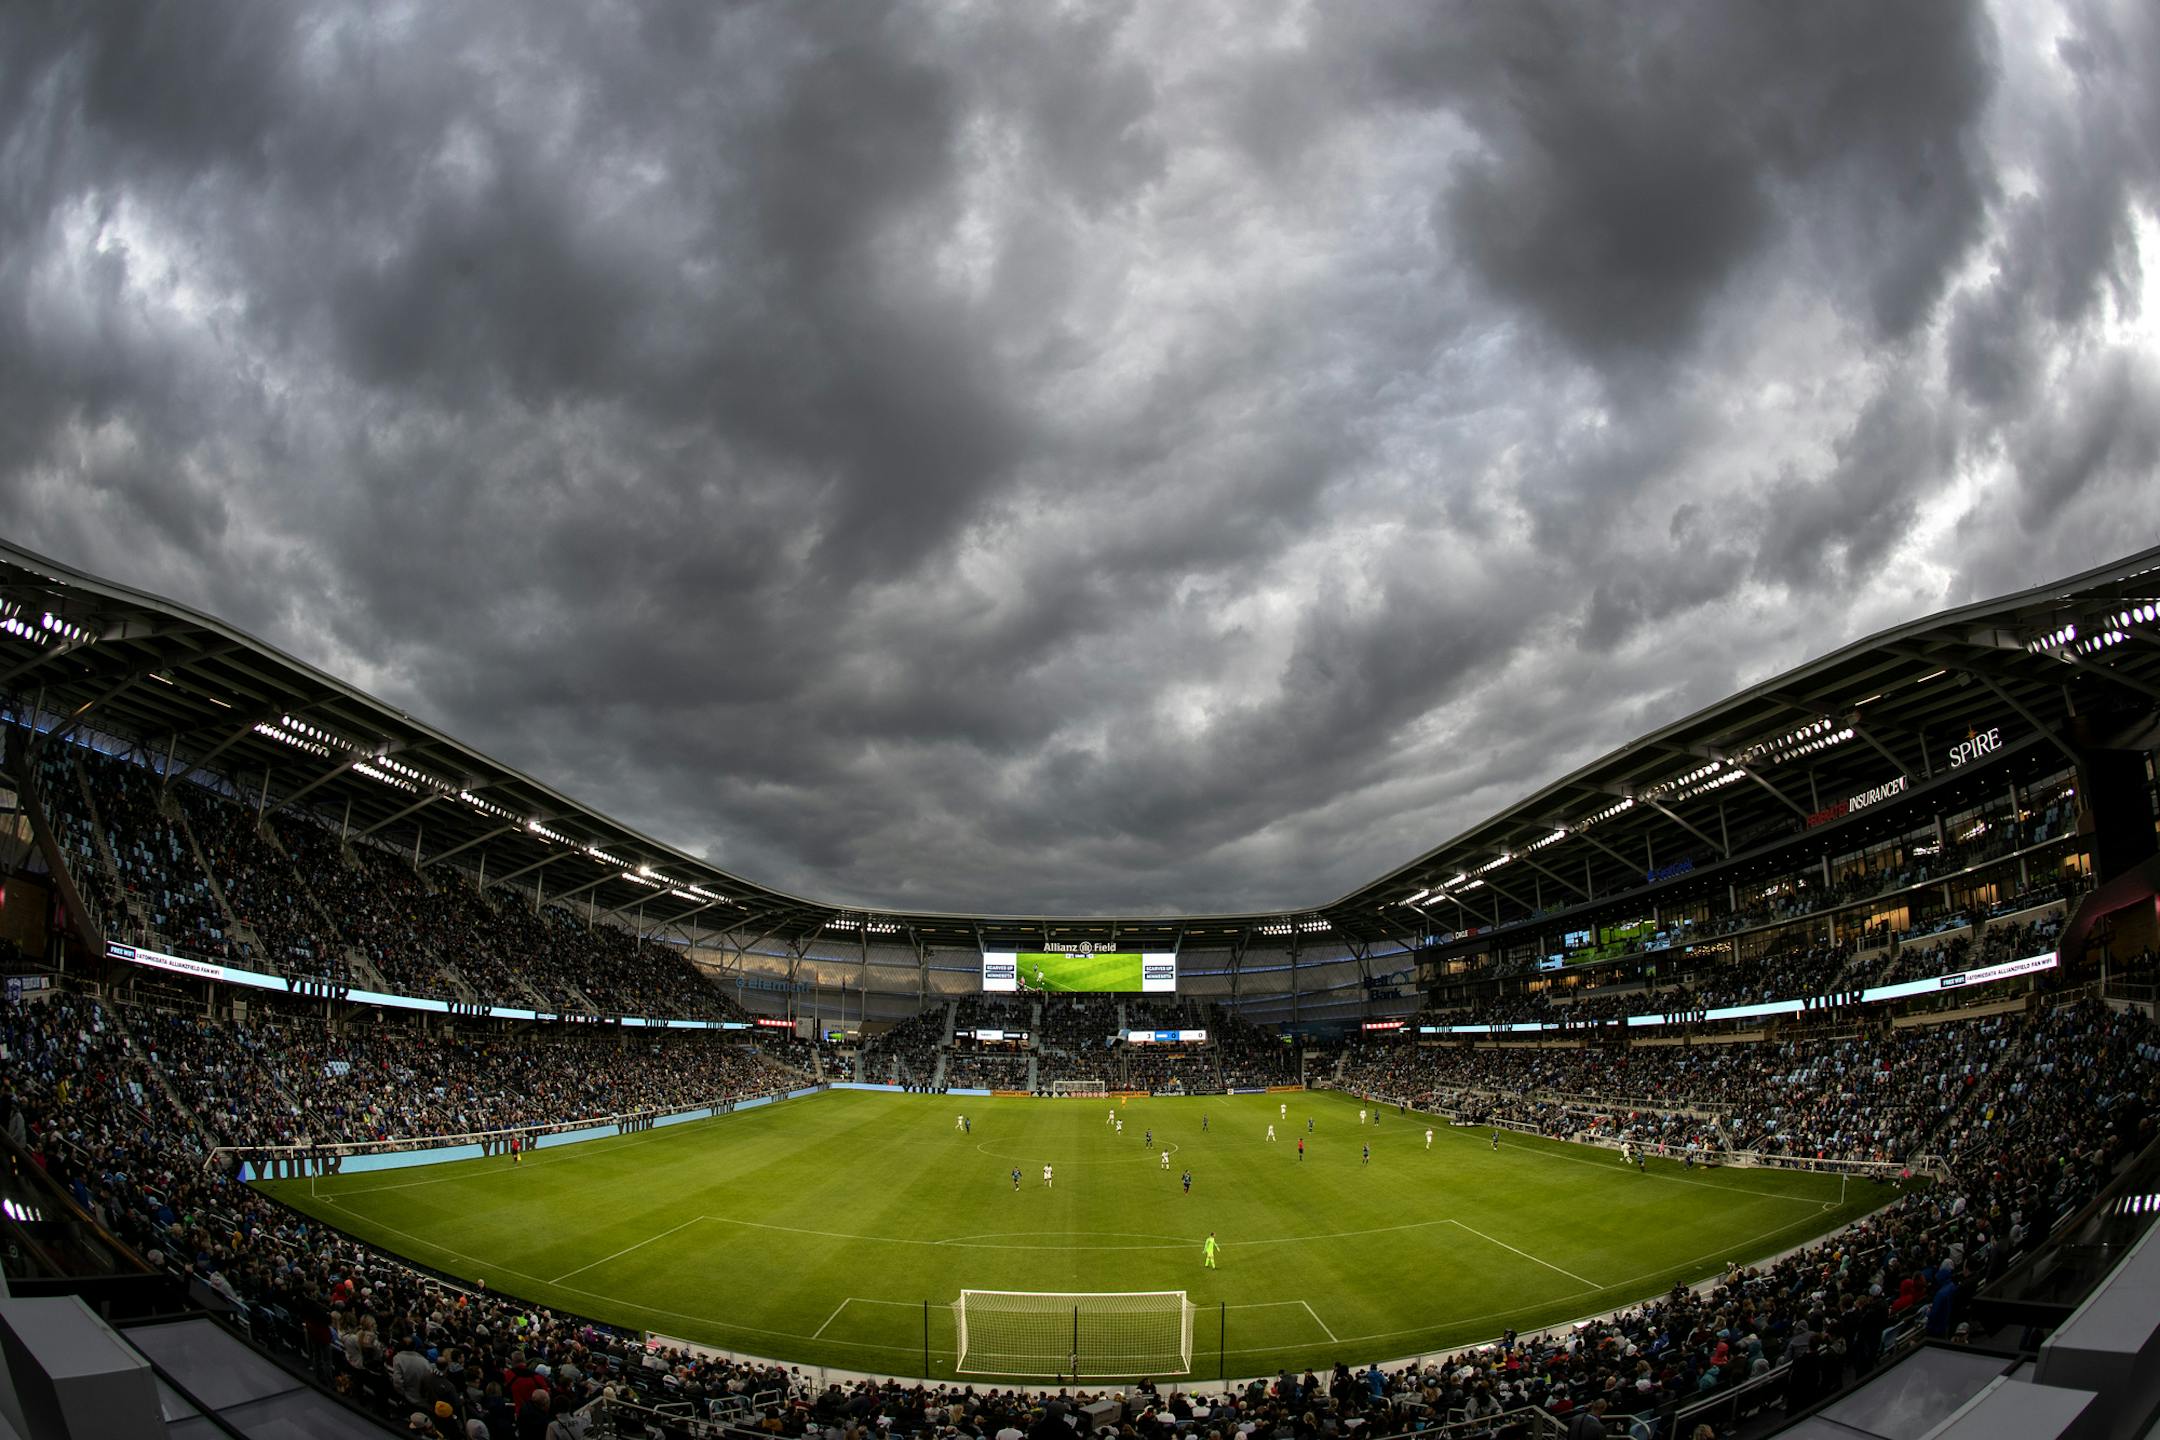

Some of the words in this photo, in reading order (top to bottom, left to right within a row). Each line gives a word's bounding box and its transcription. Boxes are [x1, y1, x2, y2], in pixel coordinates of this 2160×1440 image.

[1949, 727, 2002, 768] SPIRE
[1849, 778, 1900, 813] INSURANCE
[1043, 942, 1078, 952] Allianz
[1093, 942, 1117, 952] Field
